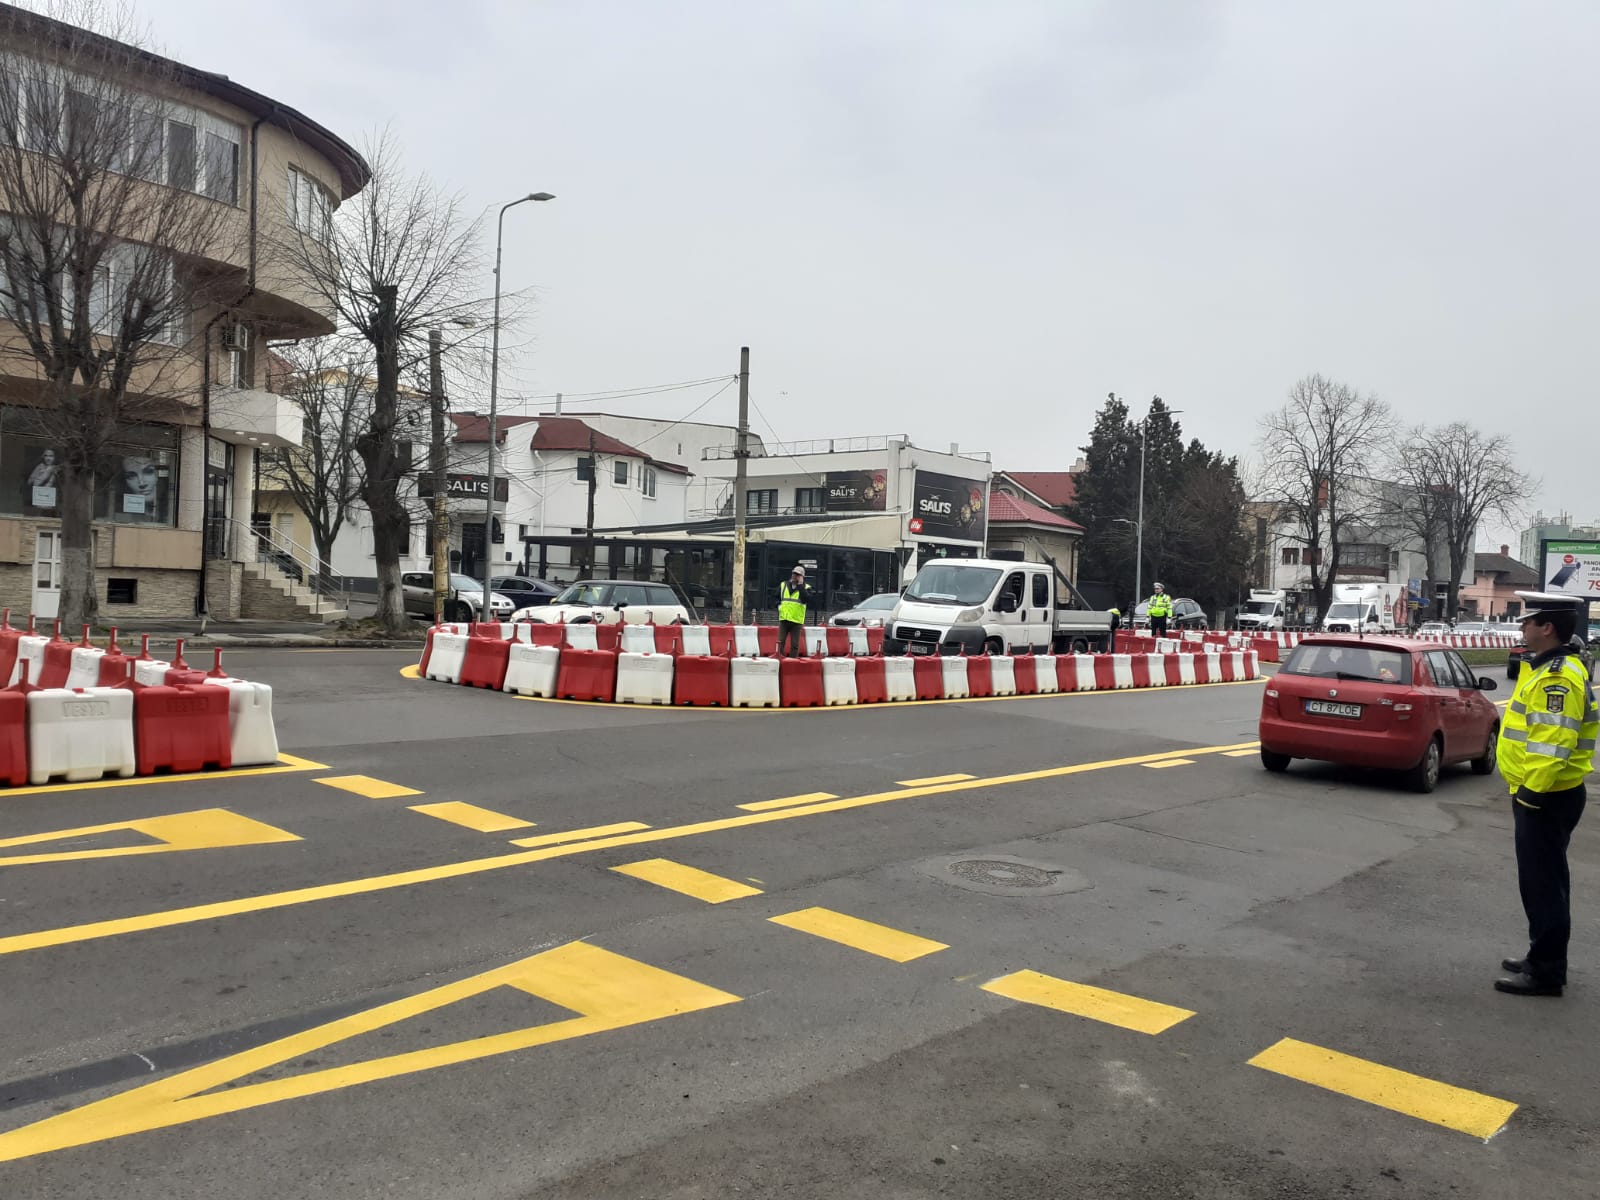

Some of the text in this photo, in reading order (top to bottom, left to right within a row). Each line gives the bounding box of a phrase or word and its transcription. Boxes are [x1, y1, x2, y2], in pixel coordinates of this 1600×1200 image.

[446, 480, 488, 493] SALI'S
[830, 488, 856, 497] SALI'S
[920, 499, 951, 514] SALI'S
[1311, 702, 1359, 717] CT 87 LOE
